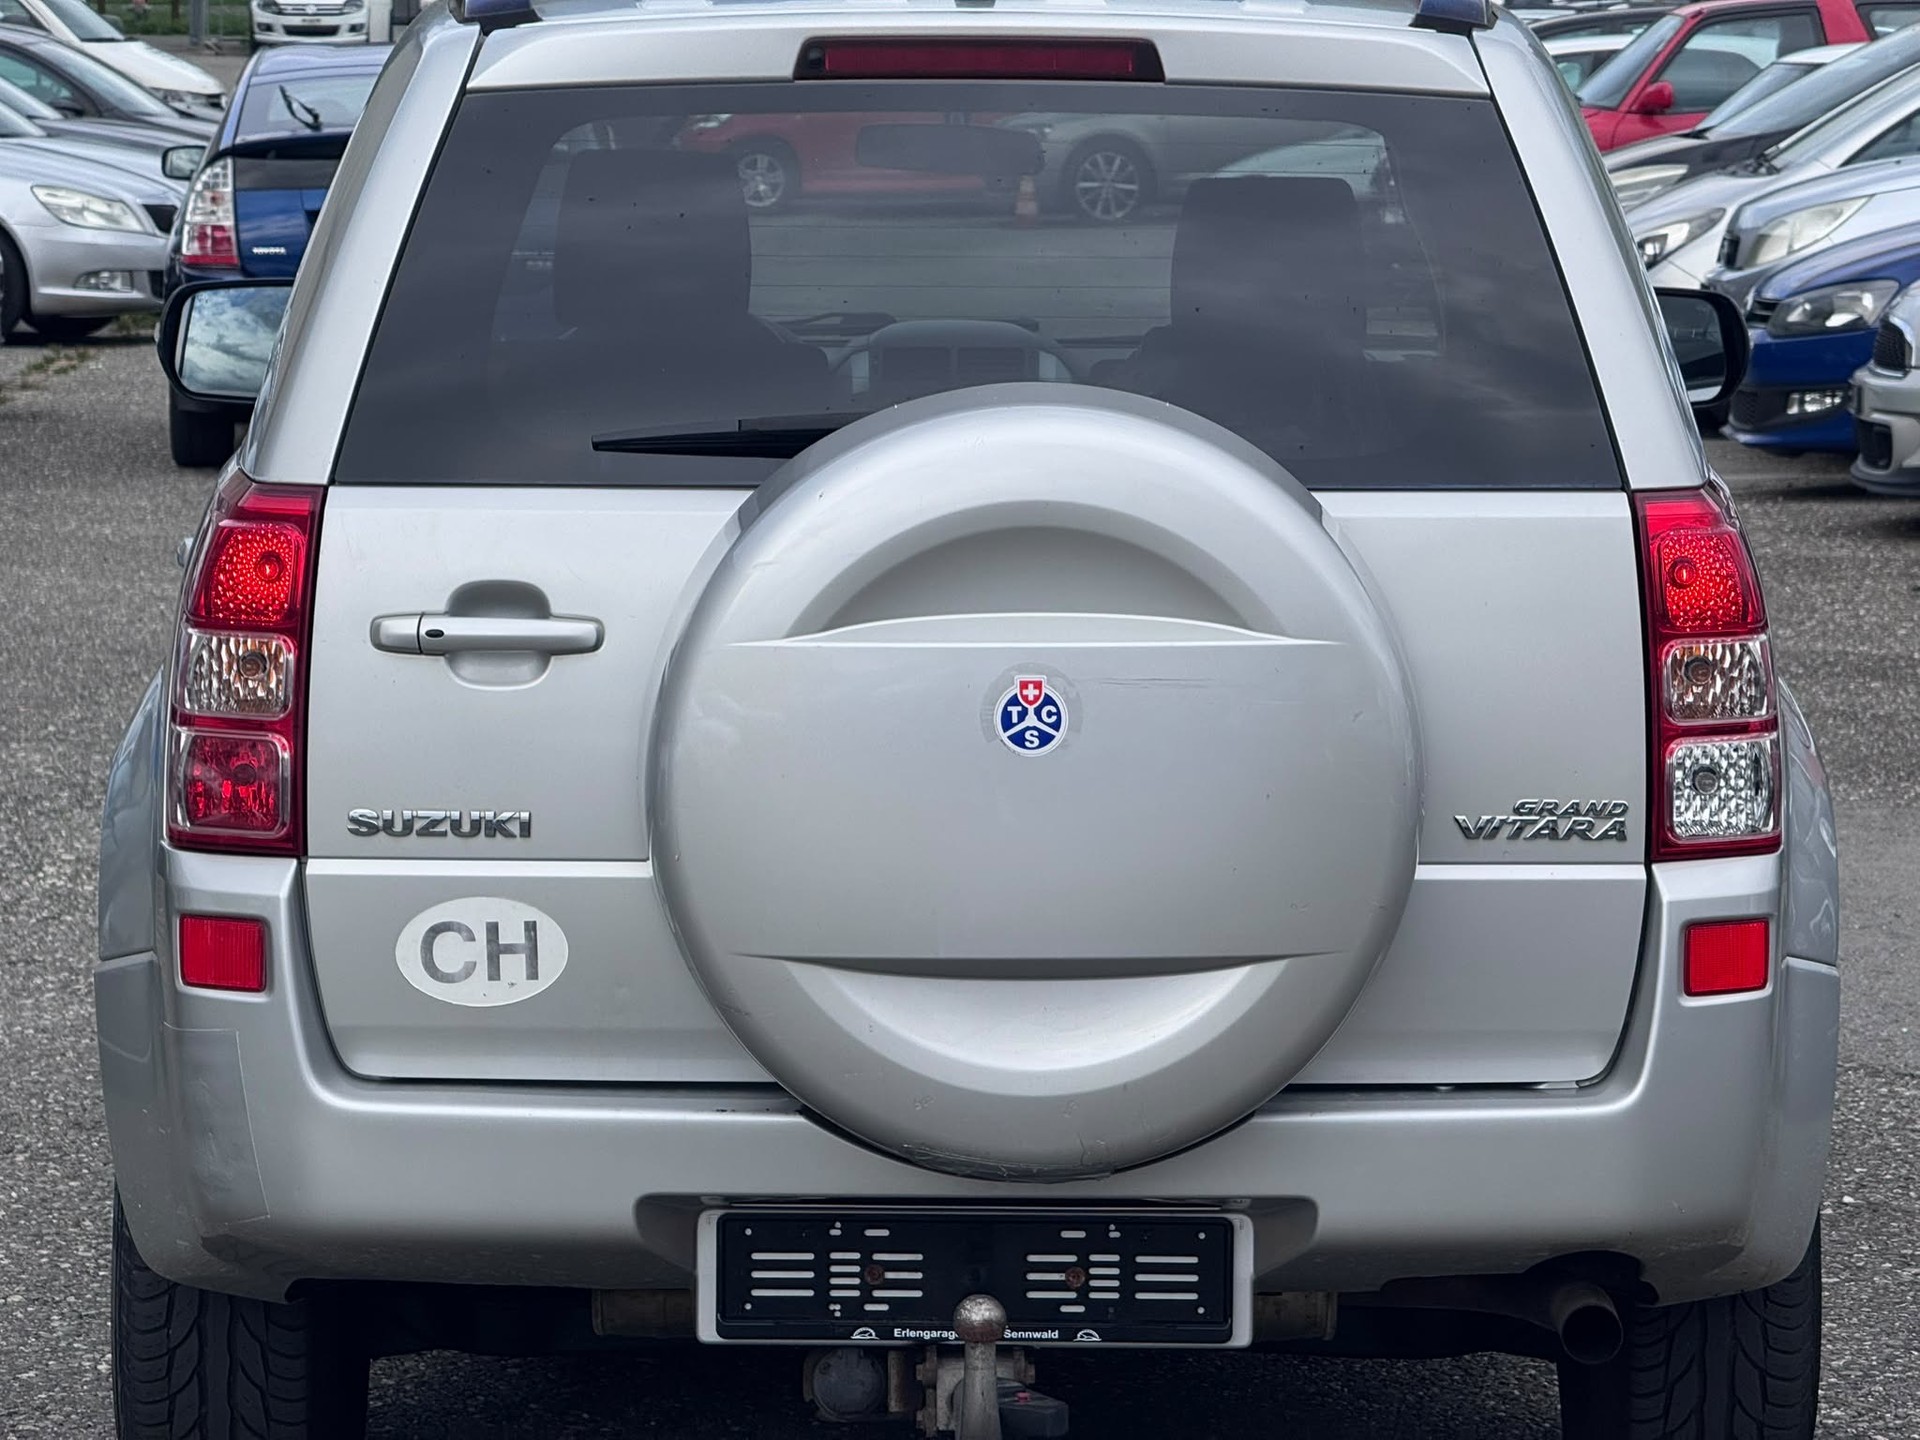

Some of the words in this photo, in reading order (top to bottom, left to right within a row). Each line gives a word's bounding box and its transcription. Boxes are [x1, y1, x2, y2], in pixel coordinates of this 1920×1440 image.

[1512, 799, 1629, 817] GRAND
[347, 808, 532, 838] SUZUKI
[1454, 815, 1628, 842] VITARA
[420, 920, 540, 984] CH
[1003, 1329, 1059, 1339] Sennwald
